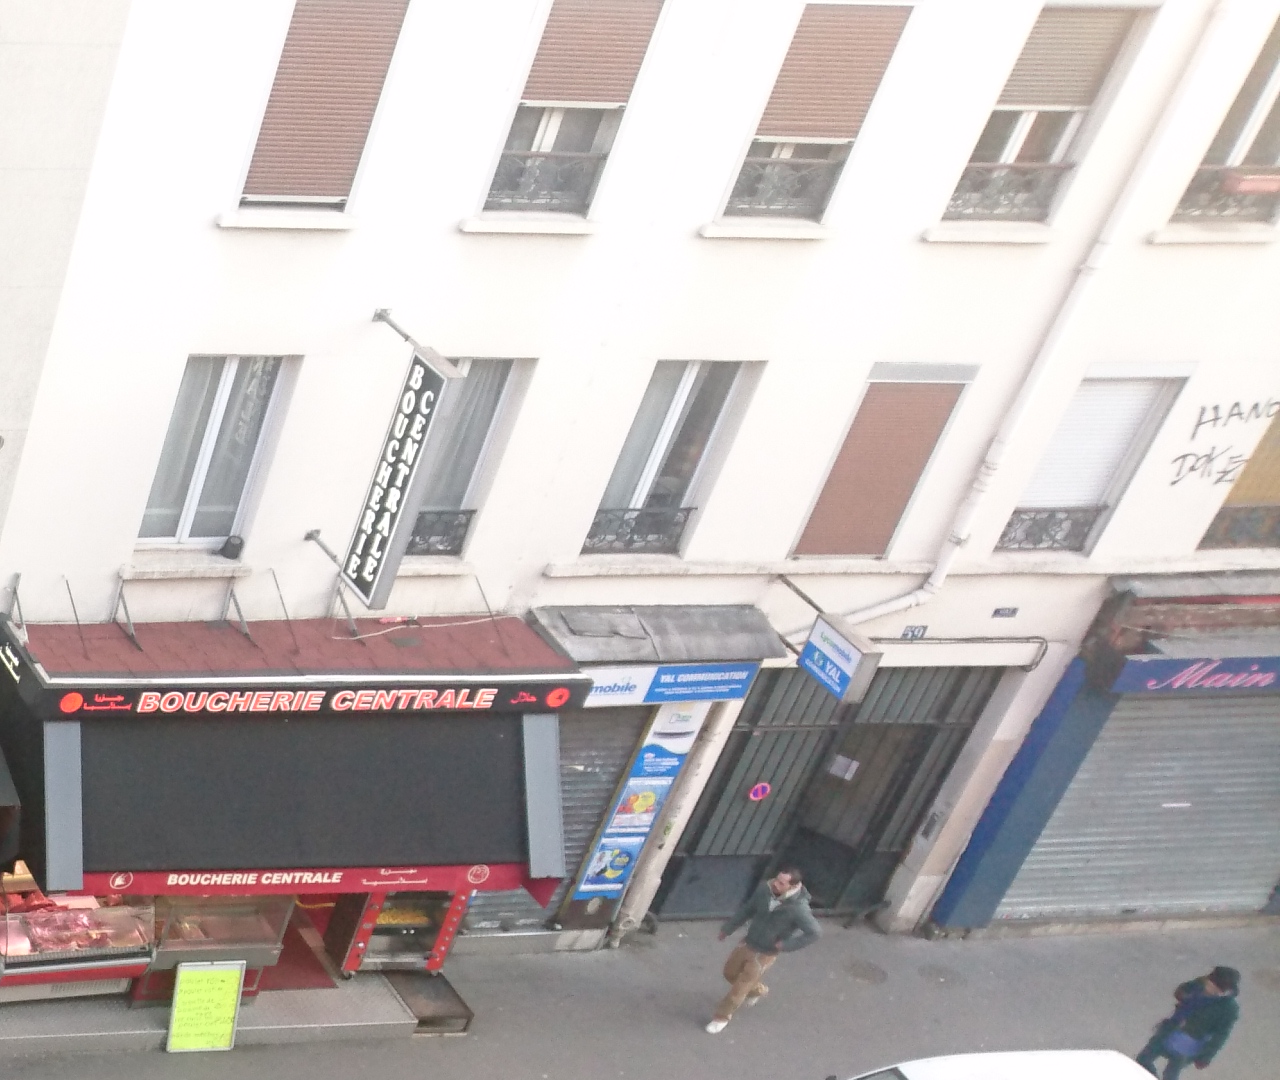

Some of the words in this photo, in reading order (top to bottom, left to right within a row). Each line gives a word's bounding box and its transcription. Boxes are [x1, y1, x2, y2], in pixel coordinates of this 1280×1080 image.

[347, 364, 425, 580] BOUCHERIE
[362, 390, 435, 582] CENTRALE
[902, 626, 926, 639] 59
[660, 673, 677, 683] YAL
[678, 671, 748, 682] COMMUNICATION
[825, 661, 842, 684] YAL
[137, 691, 326, 713] BOUCHERIE
[330, 688, 498, 711] CENTRALE
[167, 873, 257, 886] BOUCHERIE
[261, 872, 343, 885] CENTRALE
